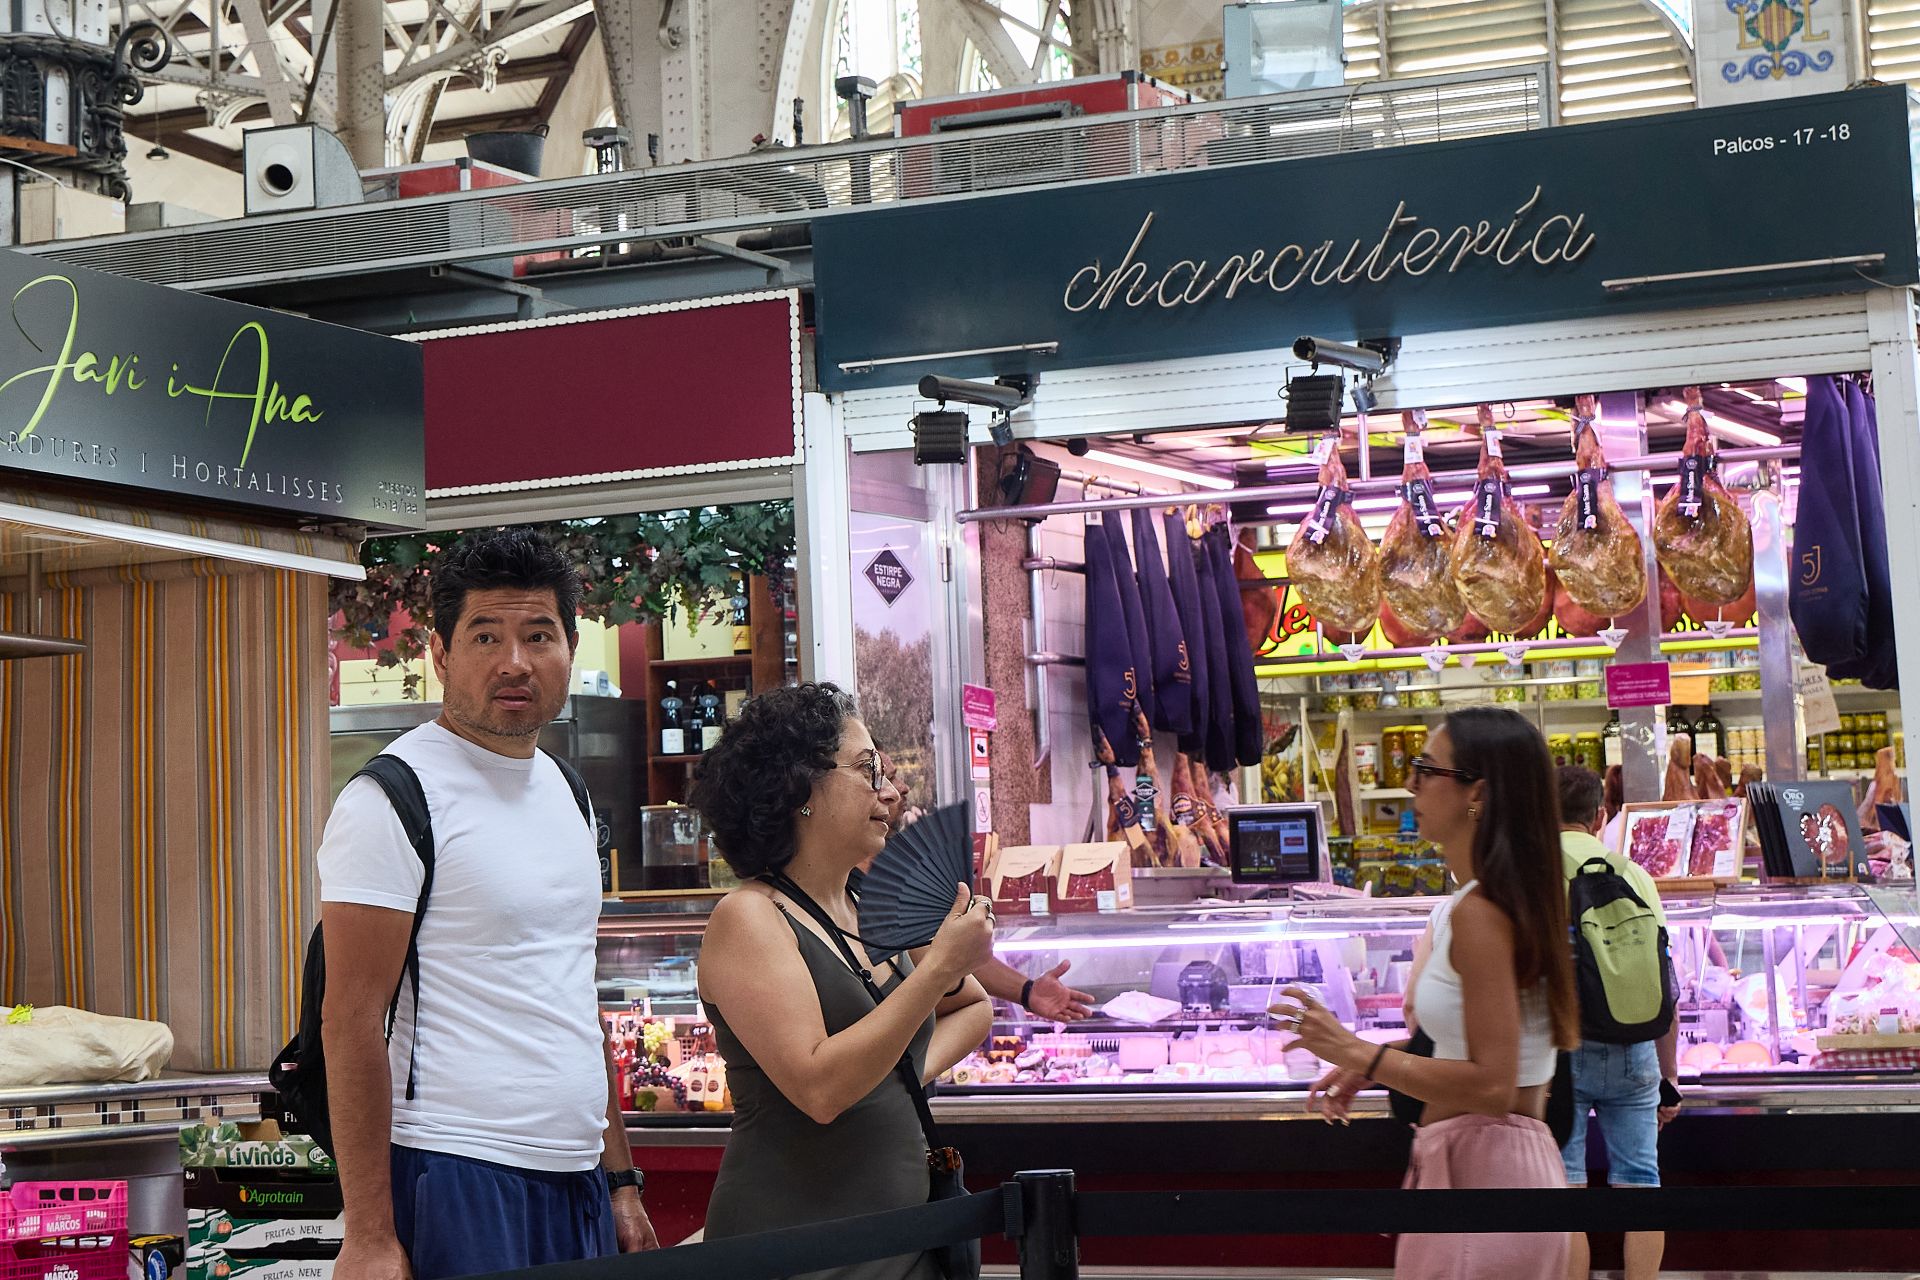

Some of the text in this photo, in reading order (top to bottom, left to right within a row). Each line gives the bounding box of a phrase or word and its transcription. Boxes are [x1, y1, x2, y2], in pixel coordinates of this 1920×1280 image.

[1713, 136, 1775, 156] Palcos
[1792, 127, 1815, 146] 17
[1063, 185, 1598, 312] charcutería
[0, 274, 149, 443] Javi
[184, 320, 325, 469] Ana
[0, 430, 345, 504] RDURES I HORTALISSES
[874, 563, 903, 578] ESTIRPE
[876, 575, 901, 589] NEGRA
[249, 1189, 304, 1207] Agrotrain
[46, 1218, 81, 1233] MARCOS
[265, 1225, 323, 1241] FRUTAS NENE
[44, 1270, 79, 1280] MARCOS
[263, 1267, 322, 1280] FRUTAS NENE
